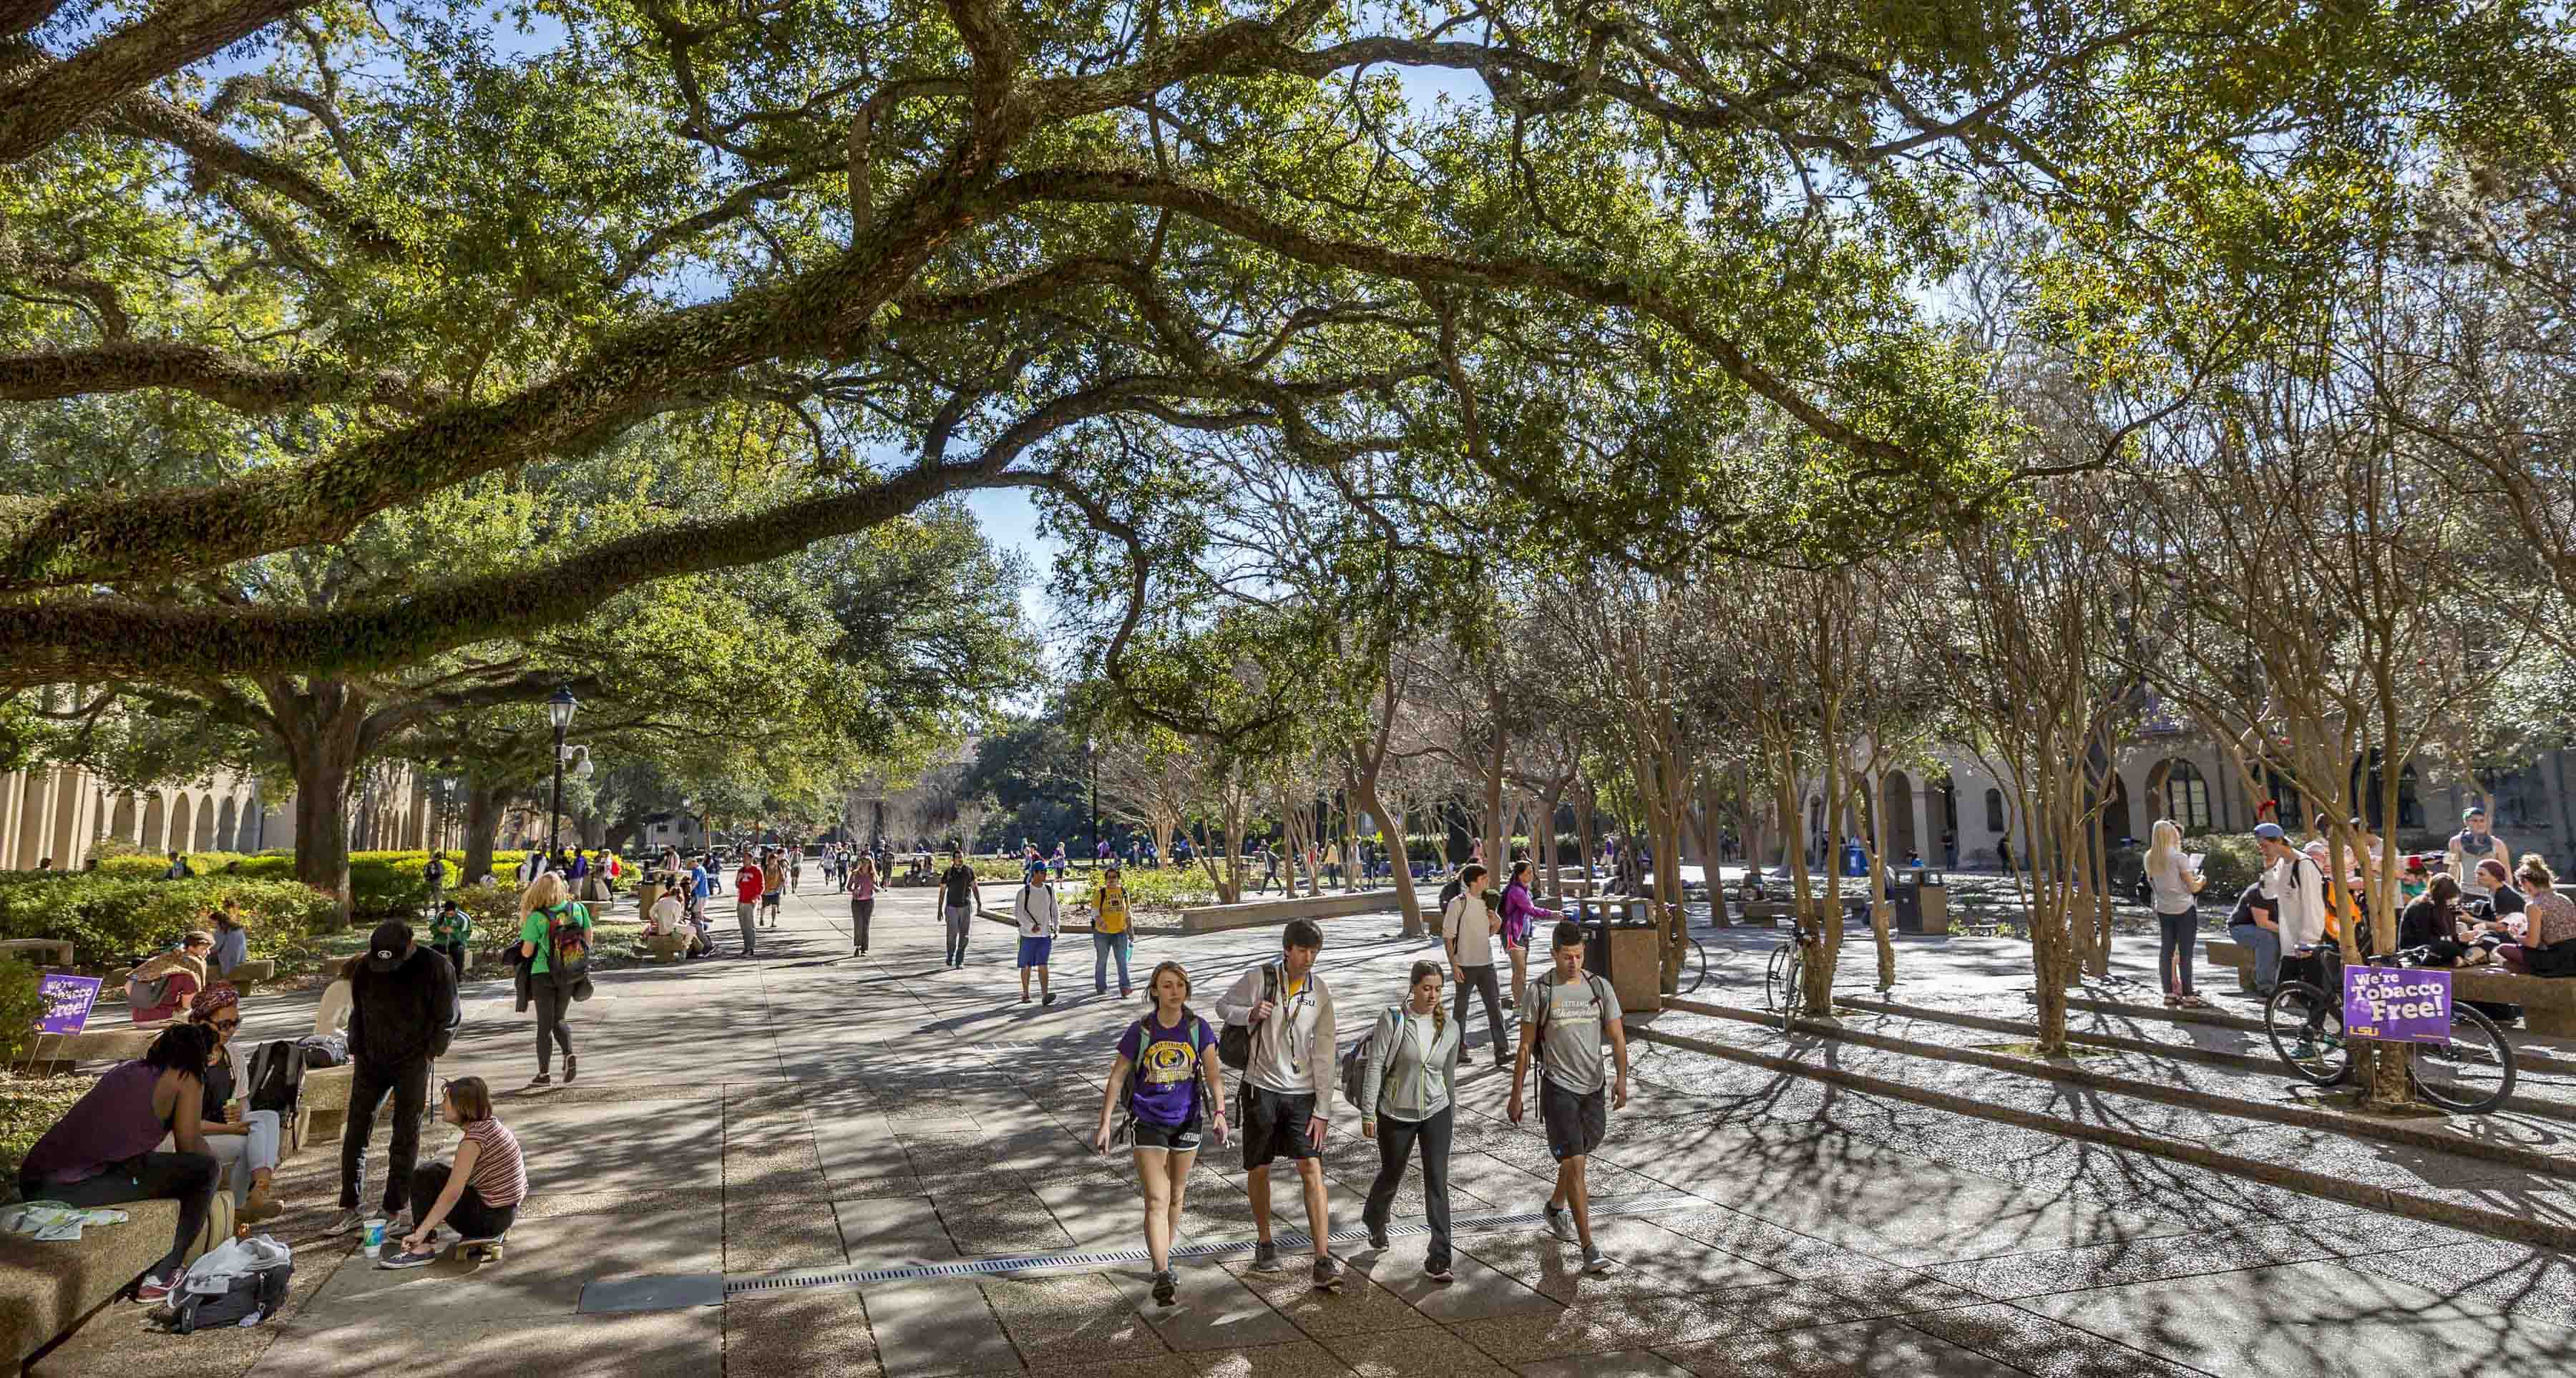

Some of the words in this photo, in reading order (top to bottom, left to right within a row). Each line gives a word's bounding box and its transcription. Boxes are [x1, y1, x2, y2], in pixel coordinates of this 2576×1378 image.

[2353, 972, 2399, 985] We're
[2351, 983, 2444, 1001] Tobacco
[2368, 995, 2444, 1022] Free!
[2348, 1025, 2381, 1037] LSU
